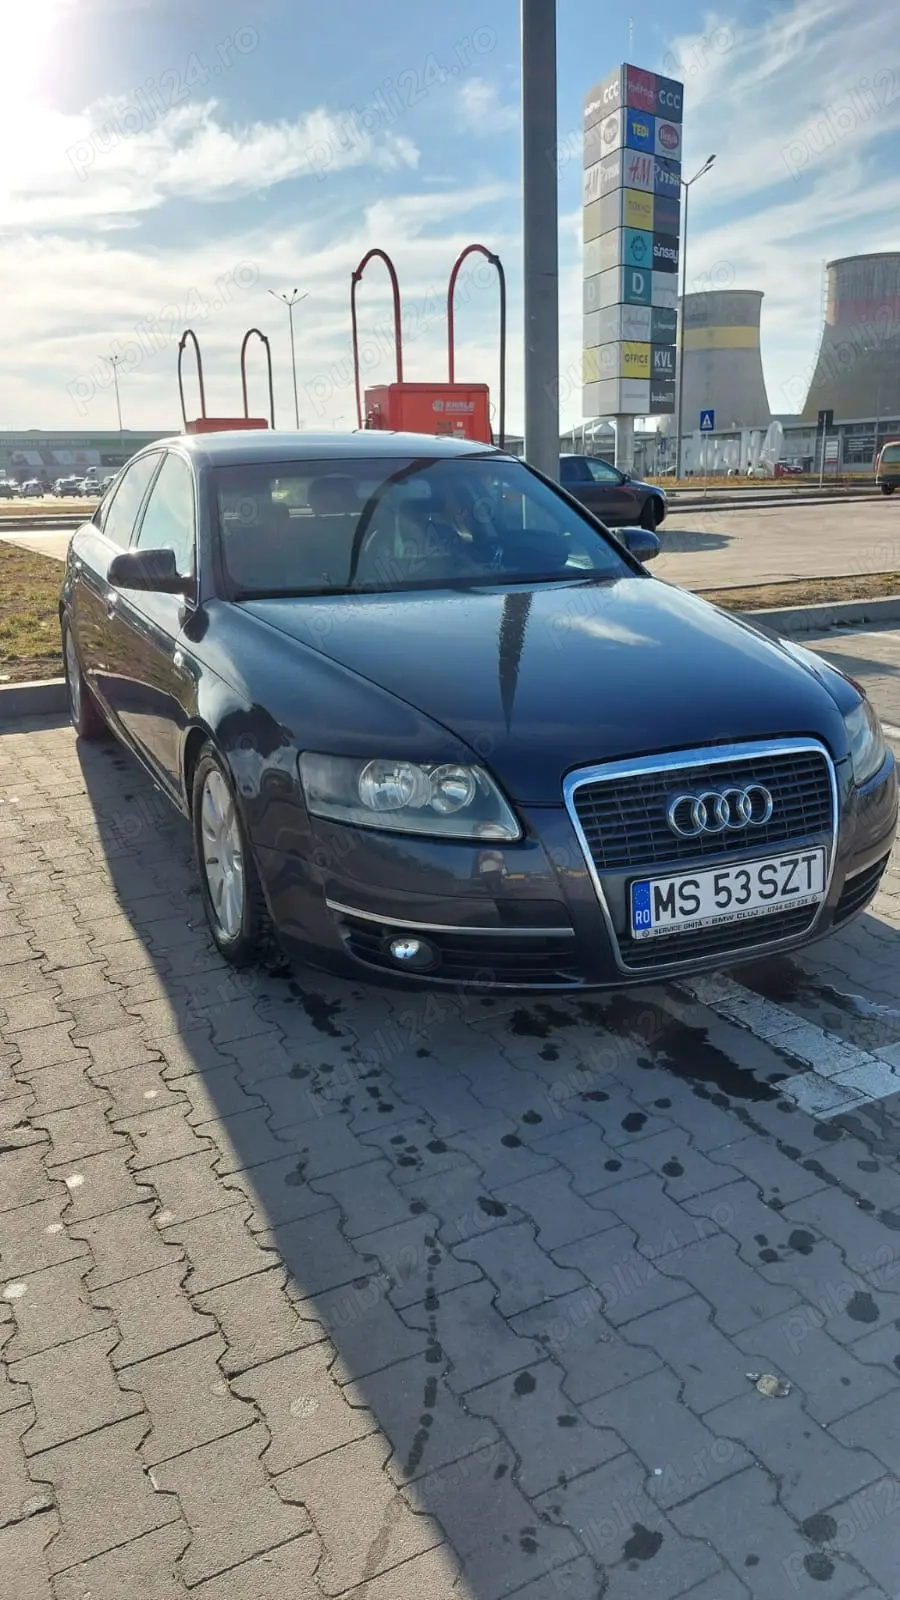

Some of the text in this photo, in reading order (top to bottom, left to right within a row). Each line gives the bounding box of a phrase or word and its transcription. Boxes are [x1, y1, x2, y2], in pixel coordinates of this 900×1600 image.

[658, 90, 681, 109] CCC
[653, 243, 679, 264] sinsay
[632, 272, 645, 294] D
[625, 353, 649, 364] OFFICE
[654, 351, 674, 368] KVL
[653, 854, 817, 922] MS 53 SZT
[635, 910, 650, 926] RO
[653, 924, 682, 936] SERVICE
[711, 914, 735, 925] BMW
[736, 908, 759, 921] CLUJ
